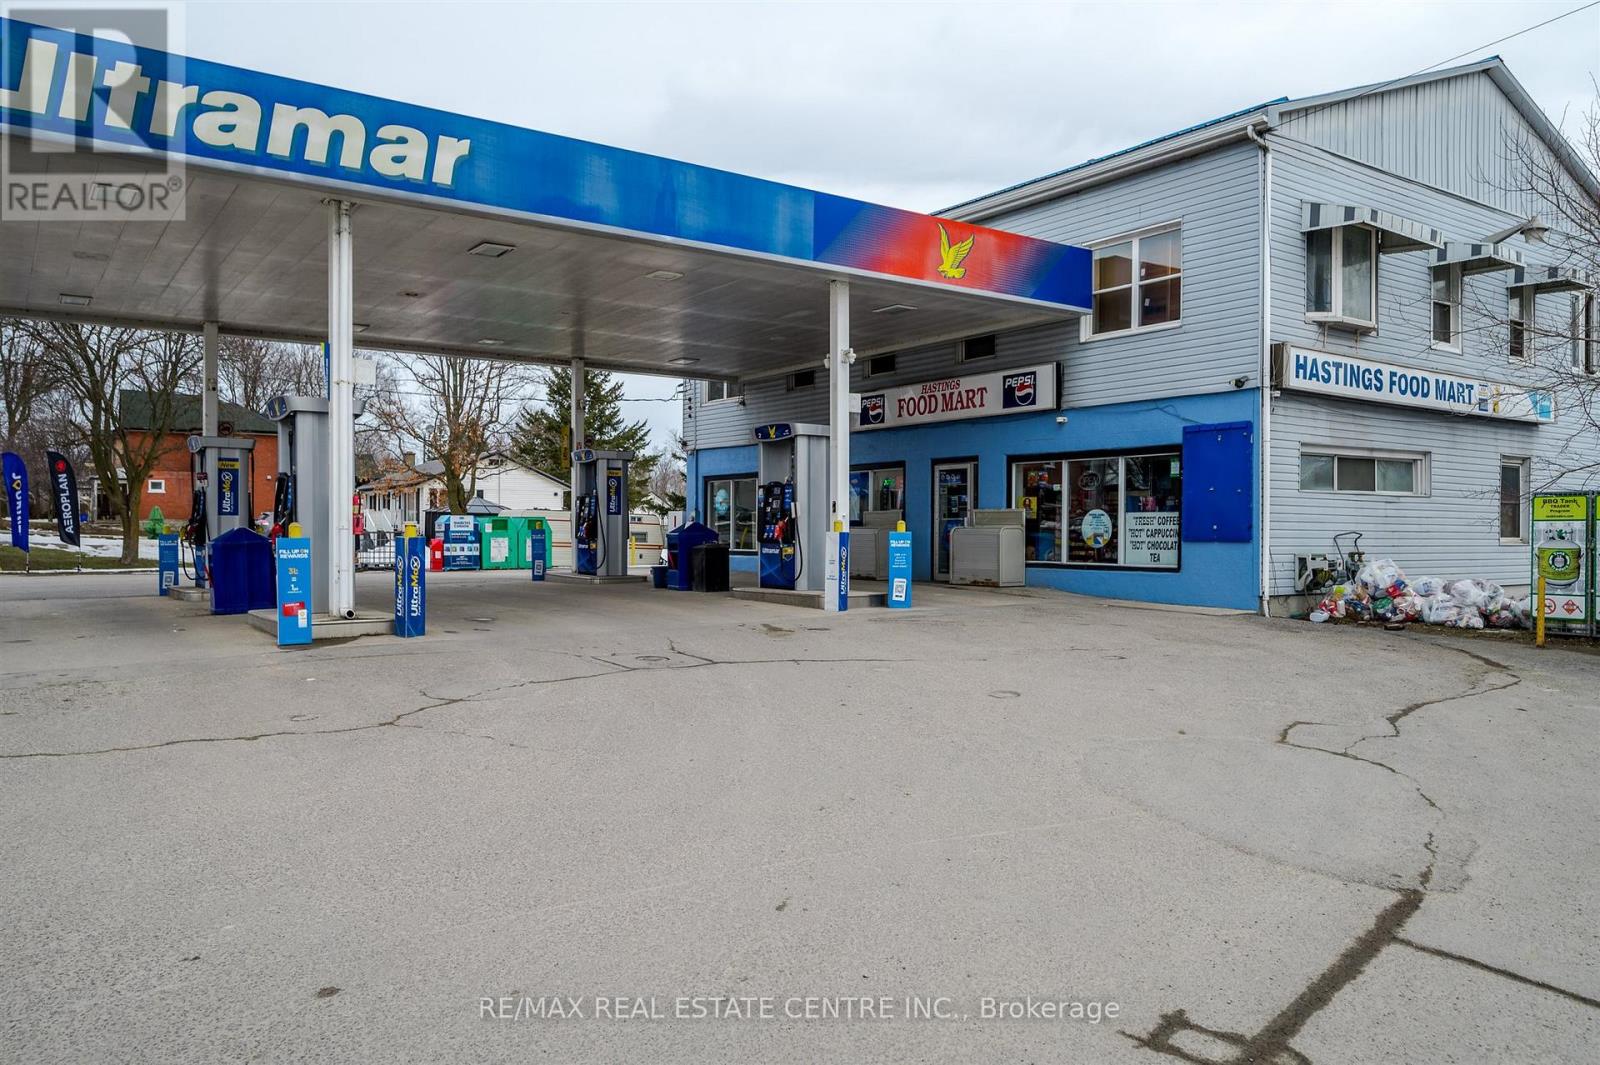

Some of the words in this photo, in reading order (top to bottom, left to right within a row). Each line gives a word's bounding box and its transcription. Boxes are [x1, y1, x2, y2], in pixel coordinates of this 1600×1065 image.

[921, 379, 961, 395] HASTINGS
[1005, 375, 1036, 388] PEPSI
[1294, 354, 1384, 392] HASTINGS
[1389, 371, 1431, 398] FOOD
[1435, 379, 1474, 405] MART
[861, 397, 883, 408] PEPSI
[897, 394, 938, 417] FOOD
[941, 387, 988, 412] MART
[58, 474, 74, 534] AEROPLAN
[1150, 553, 1161, 562] TEA
